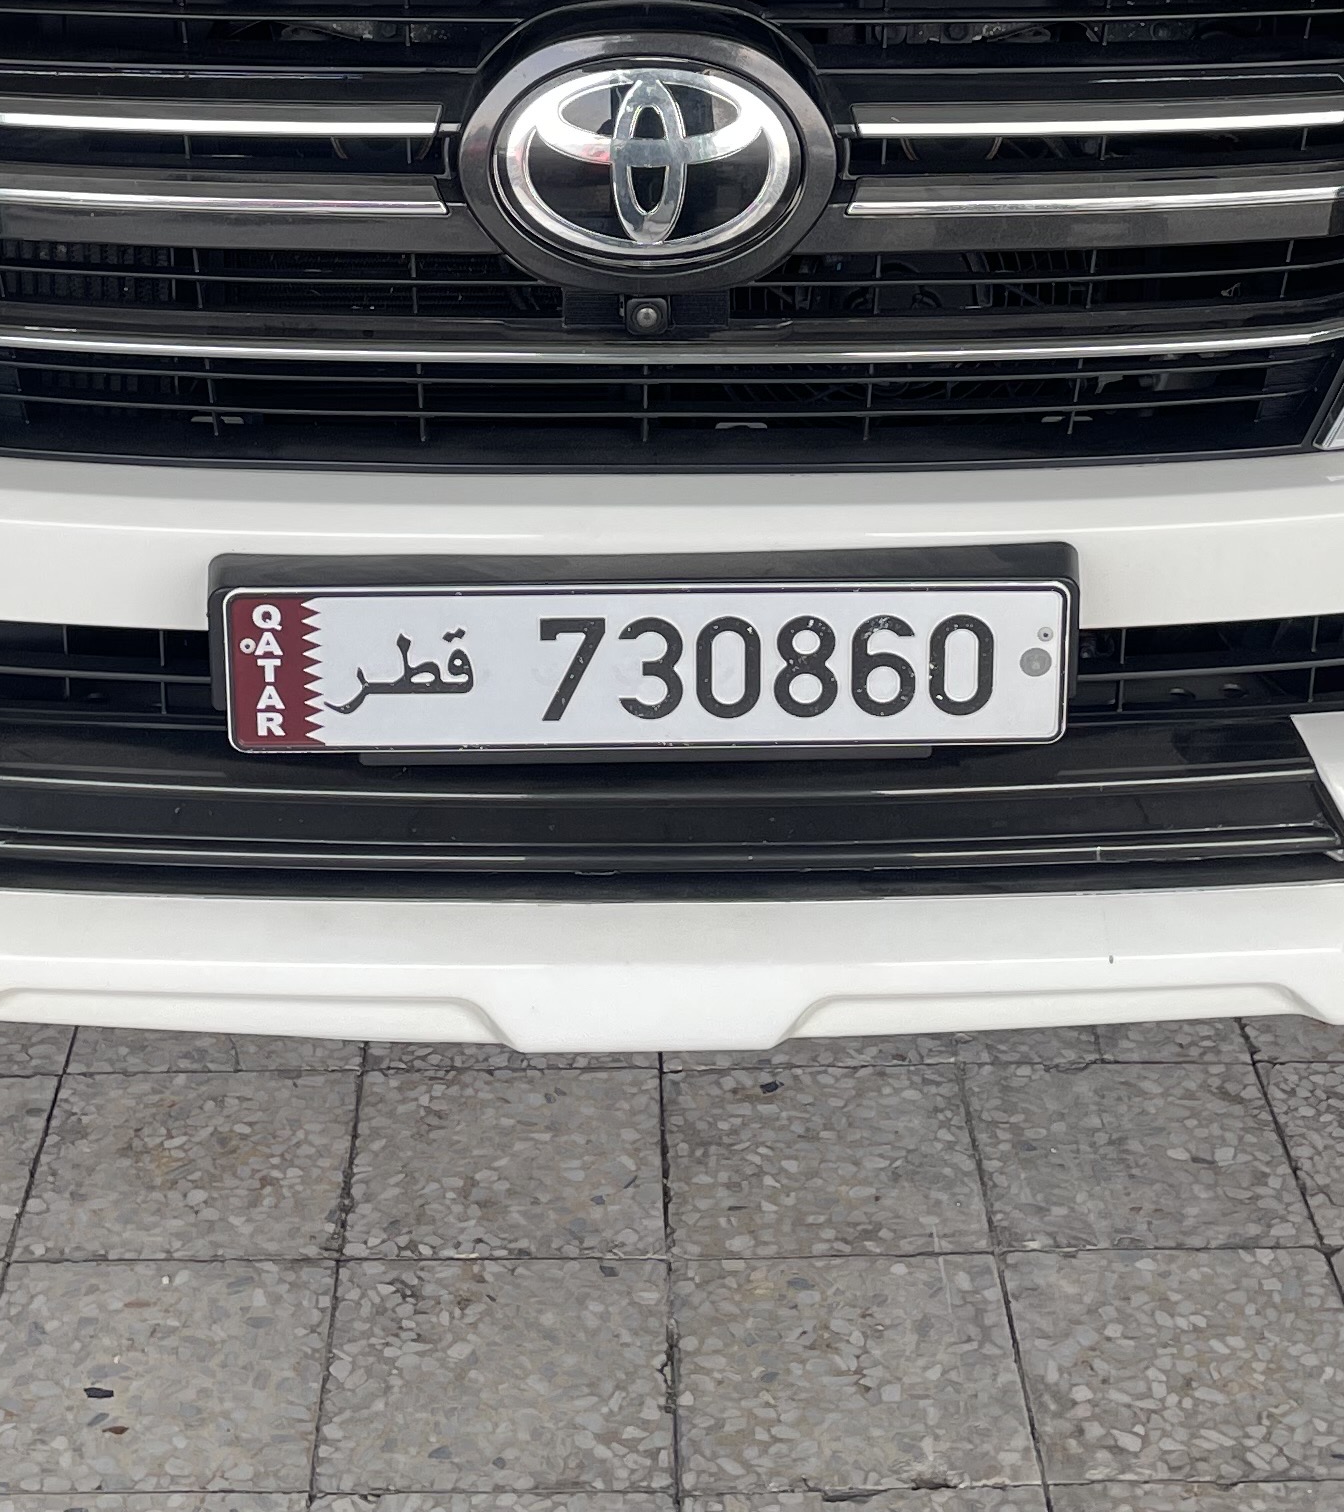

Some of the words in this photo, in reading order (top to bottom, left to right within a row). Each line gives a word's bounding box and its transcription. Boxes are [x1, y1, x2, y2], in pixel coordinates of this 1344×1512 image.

[251, 604, 285, 738] QATAR
[324, 627, 475, 714] قطر
[539, 614, 996, 722] 730860
